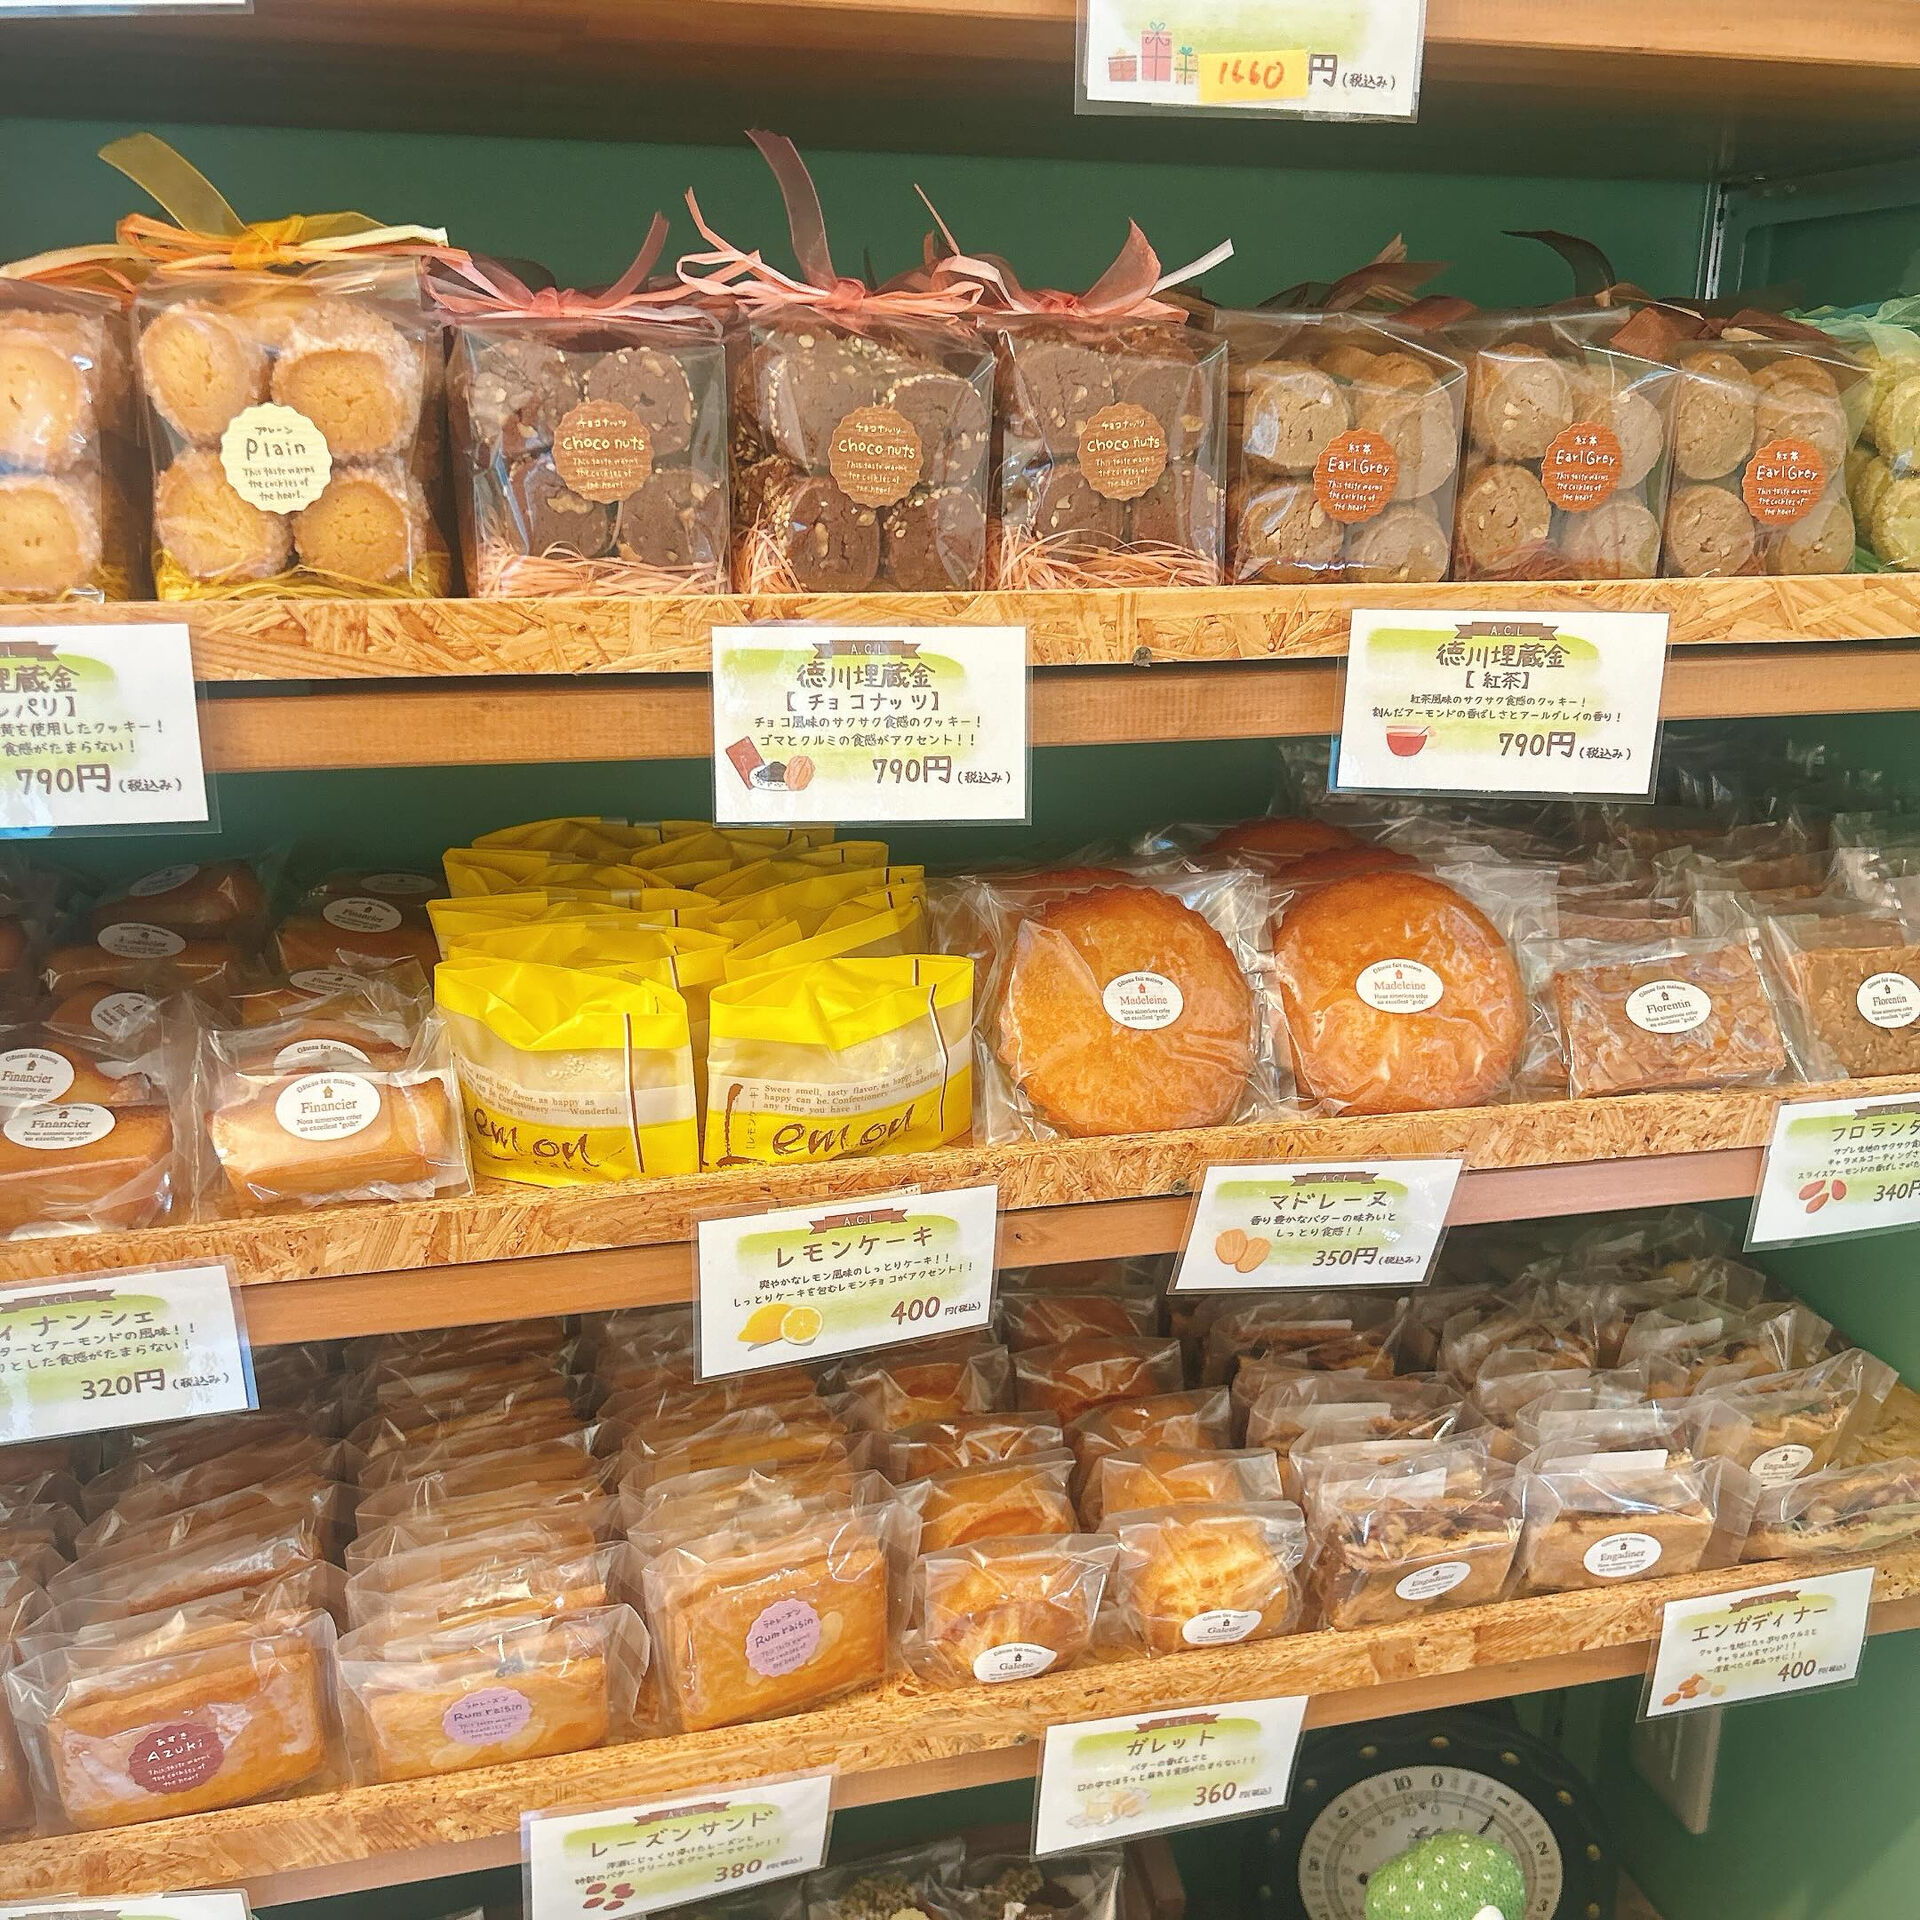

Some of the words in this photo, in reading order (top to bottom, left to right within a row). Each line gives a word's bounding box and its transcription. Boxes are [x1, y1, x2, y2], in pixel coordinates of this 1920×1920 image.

[1218, 60, 1284, 89] 1660
[1309, 54, 1338, 87] 円
[246, 438, 306, 461] Plain
[614, 436, 645, 451] nuts
[888, 444, 915, 459] nuts
[1133, 435, 1160, 448] nuts
[1436, 641, 1570, 669] 徳川埋蔵金
[797, 660, 936, 690] 徳川埋蔵金
[1465, 670, 1530, 690] 【紅茶】
[1499, 731, 1576, 758] 790円
[16, 764, 111, 795] 790円
[872, 755, 951, 784] 790円
[1374, 981, 1426, 991] Madeleine
[1119, 995, 1168, 1006] Madeleine
[1646, 1000, 1691, 1014] Florentin
[1, 1070, 53, 1083] Financier
[764, 1085, 790, 1094] Sweet
[827, 1089, 848, 1097] tasty
[764, 1094, 790, 1103] happy
[301, 1099, 357, 1113] Financier
[552, 1097, 579, 1108] happy
[763, 1102, 779, 1110] any
[785, 1103, 804, 1112] time
[831, 1105, 850, 1113] have
[31, 1120, 90, 1129] Financier
[474, 1107, 600, 1167] emon
[1269, 1190, 1388, 1211] マドレーヌ
[776, 1225, 934, 1268] レモンケーキ
[1312, 1246, 1379, 1267] 350円
[891, 1296, 941, 1325] 400
[80, 1368, 166, 1400] 320円
[1691, 1605, 1828, 1642] エンガディナー
[1778, 1660, 1816, 1681] 400
[454, 1712, 482, 1721] Rum
[147, 1739, 203, 1762] Azuki
[1126, 1730, 1215, 1757] ガレット
[1431, 1772, 1444, 1788] 0
[1193, 1782, 1237, 1807] 360
[592, 1810, 774, 1858] レーズンサンド
[714, 1859, 762, 1883] 380
